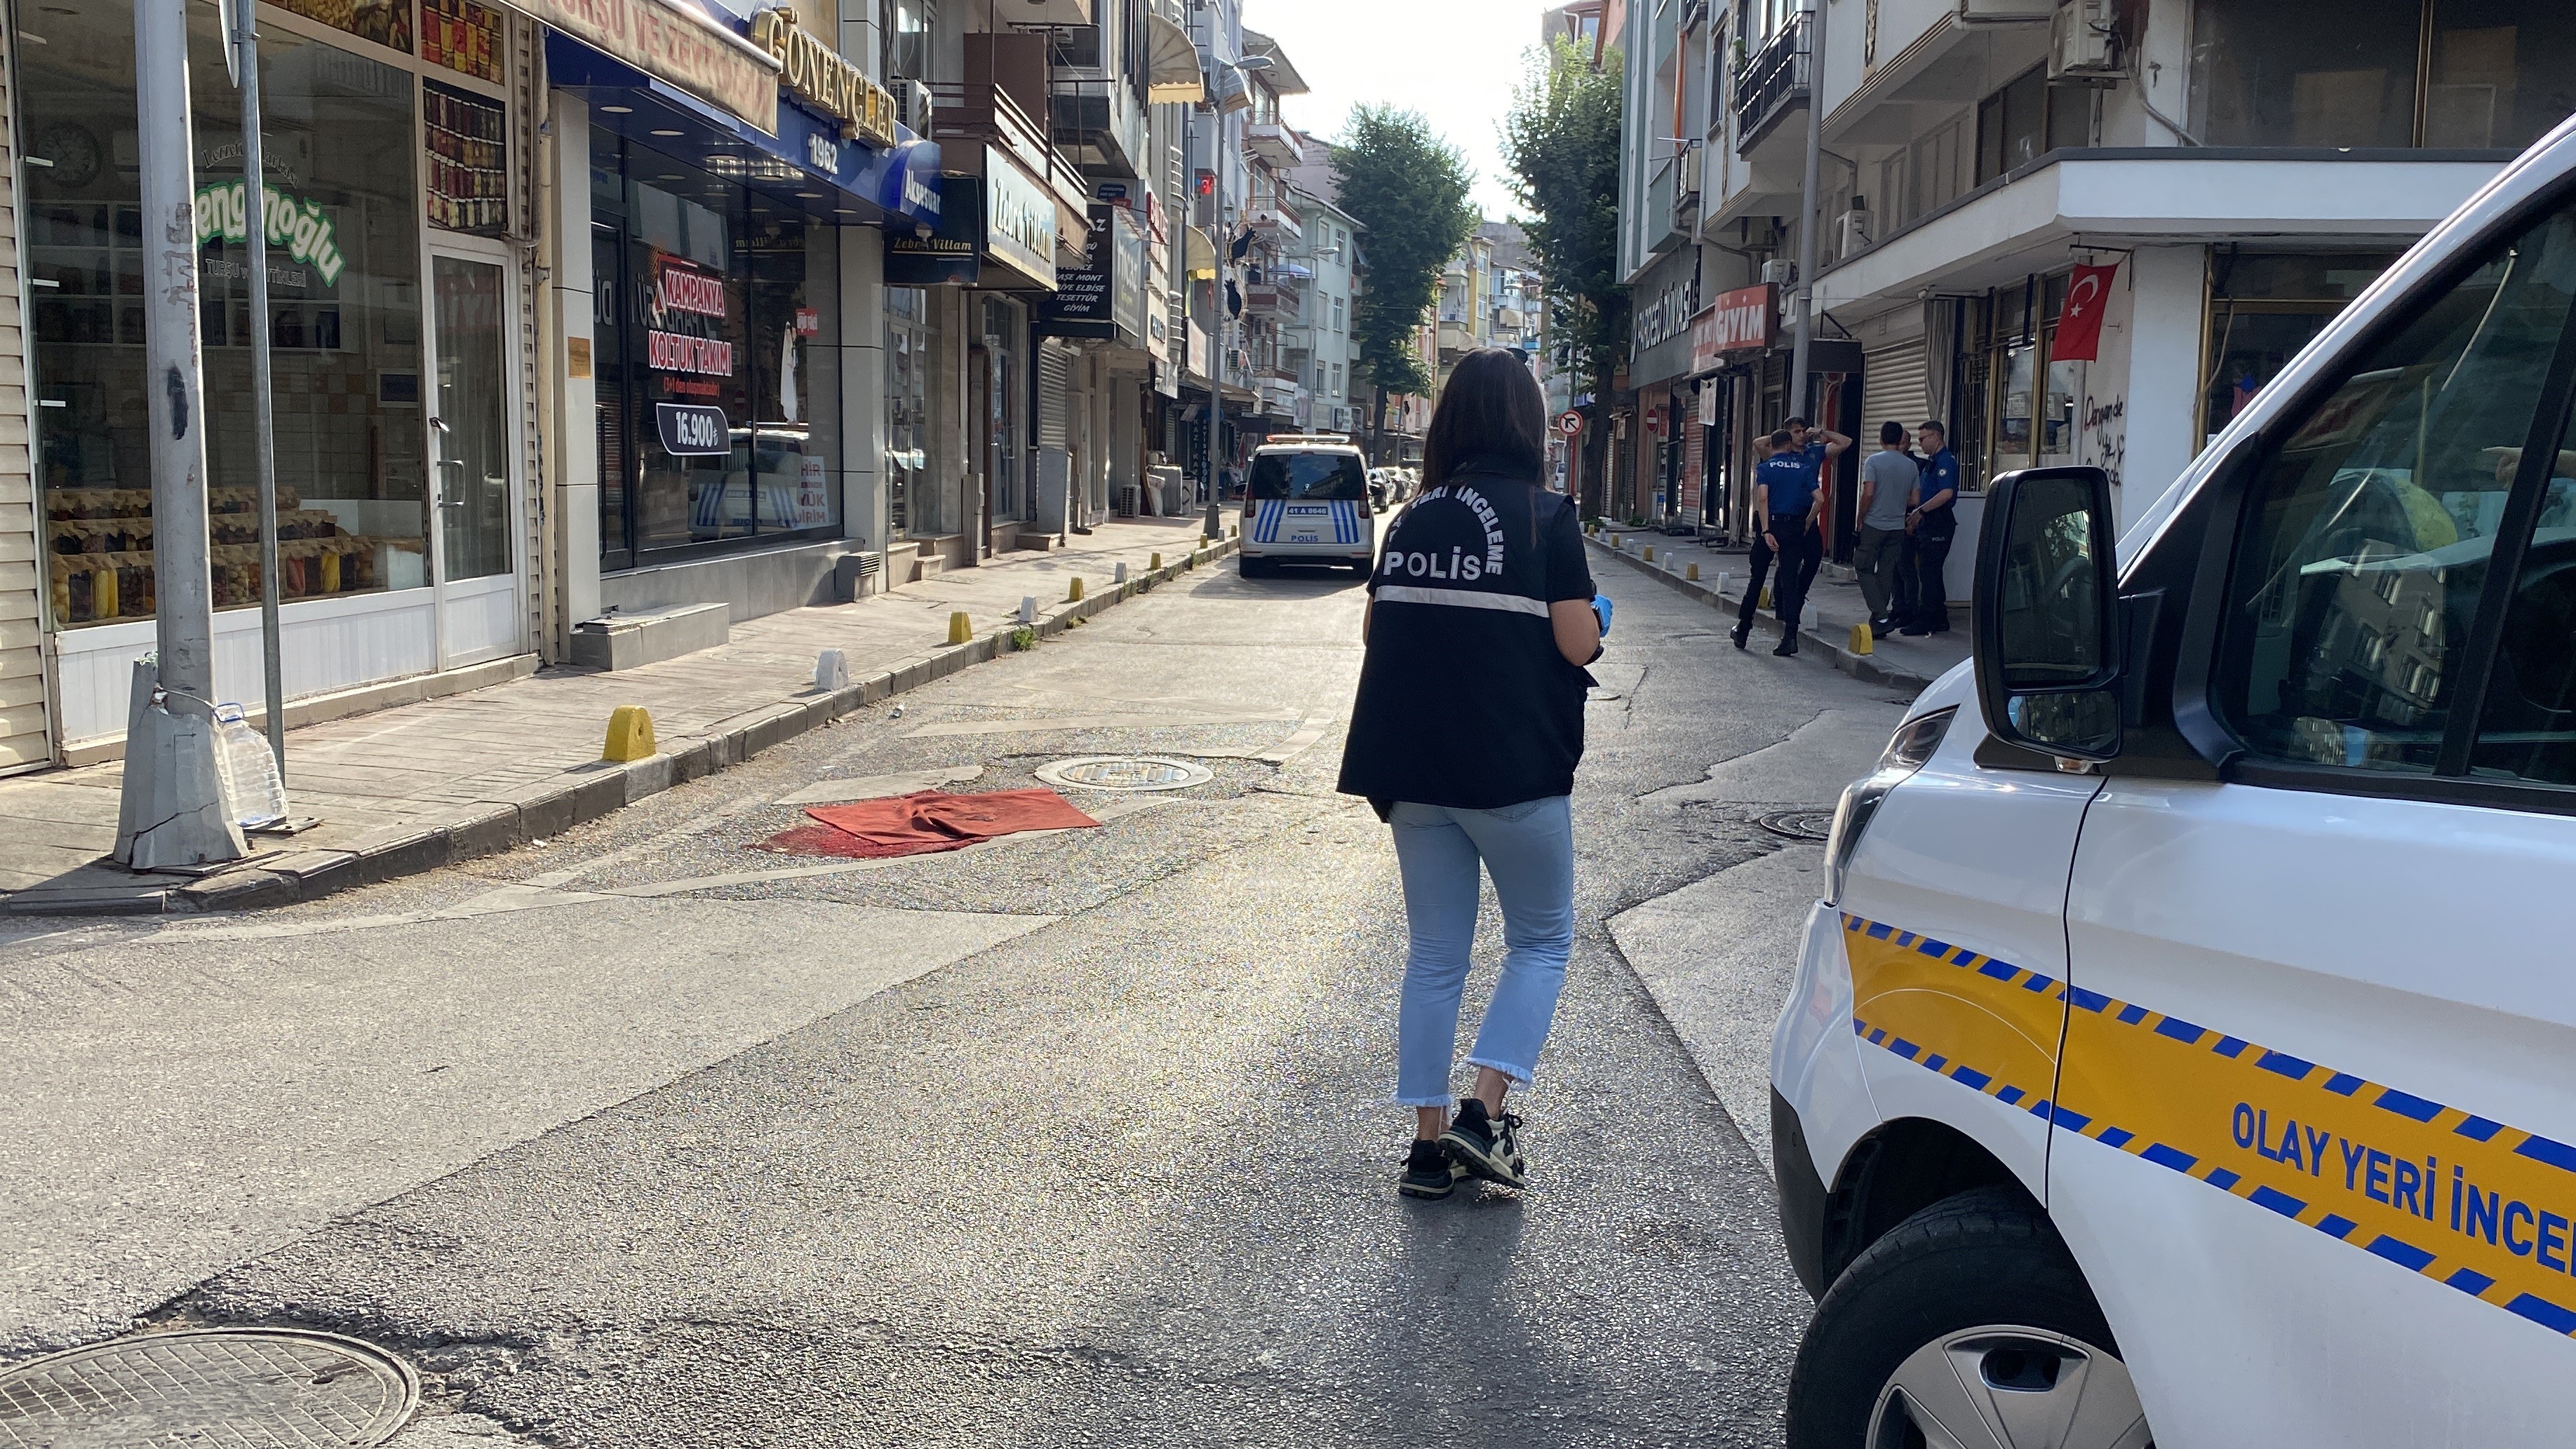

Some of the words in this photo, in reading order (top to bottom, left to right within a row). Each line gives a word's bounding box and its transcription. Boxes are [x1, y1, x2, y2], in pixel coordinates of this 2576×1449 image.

[631, 6, 659, 58] VE
[765, 6, 897, 149] GÖNENÇLER
[201, 142, 243, 168] Lezzeti
[262, 145, 300, 189] arkası
[810, 133, 838, 175] 1962
[904, 169, 941, 215] Aksesuar
[196, 182, 343, 283] engnoğlu
[894, 238, 927, 250] Zebr
[931, 239, 972, 250] Villam
[206, 258, 239, 279] TURŞU
[267, 266, 307, 288] TİNLERİ
[666, 269, 725, 316] KAMPANYA
[1057, 283, 1075, 291] İYE
[1075, 283, 1106, 292] ELBİSE
[1056, 294, 1099, 302] TESETTÜR
[1063, 303, 1090, 312] GİYİM
[1716, 295, 1764, 345] GİYİM
[648, 330, 695, 372] KOLTUK
[695, 337, 732, 377] TAKIMI
[801, 461, 821, 477] HİR
[1383, 546, 1481, 581] POLİS
[2232, 1102, 2330, 1178] OLAY
[2339, 1137, 2436, 1222] YERİ
